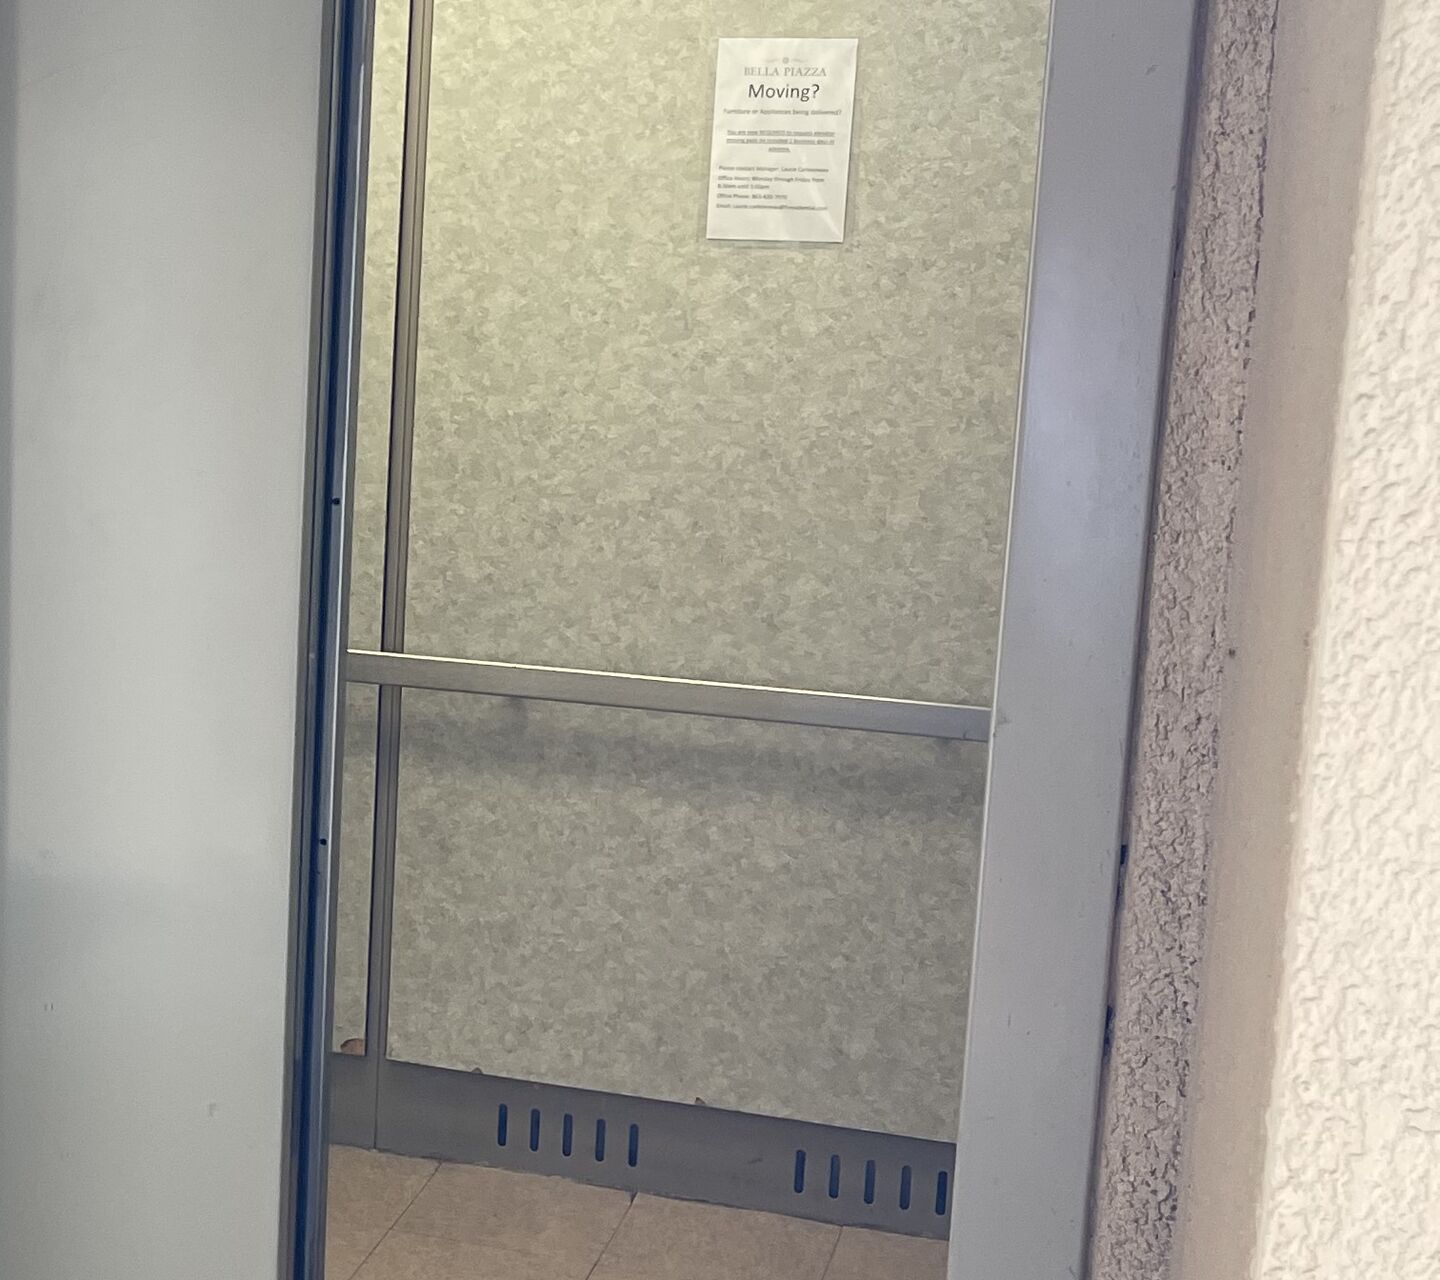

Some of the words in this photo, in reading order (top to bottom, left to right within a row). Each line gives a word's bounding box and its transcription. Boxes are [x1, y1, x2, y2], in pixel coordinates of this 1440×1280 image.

[744, 67, 779, 77] BELLA
[784, 67, 826, 77] PIAZZA
[748, 84, 820, 102] Moving?
